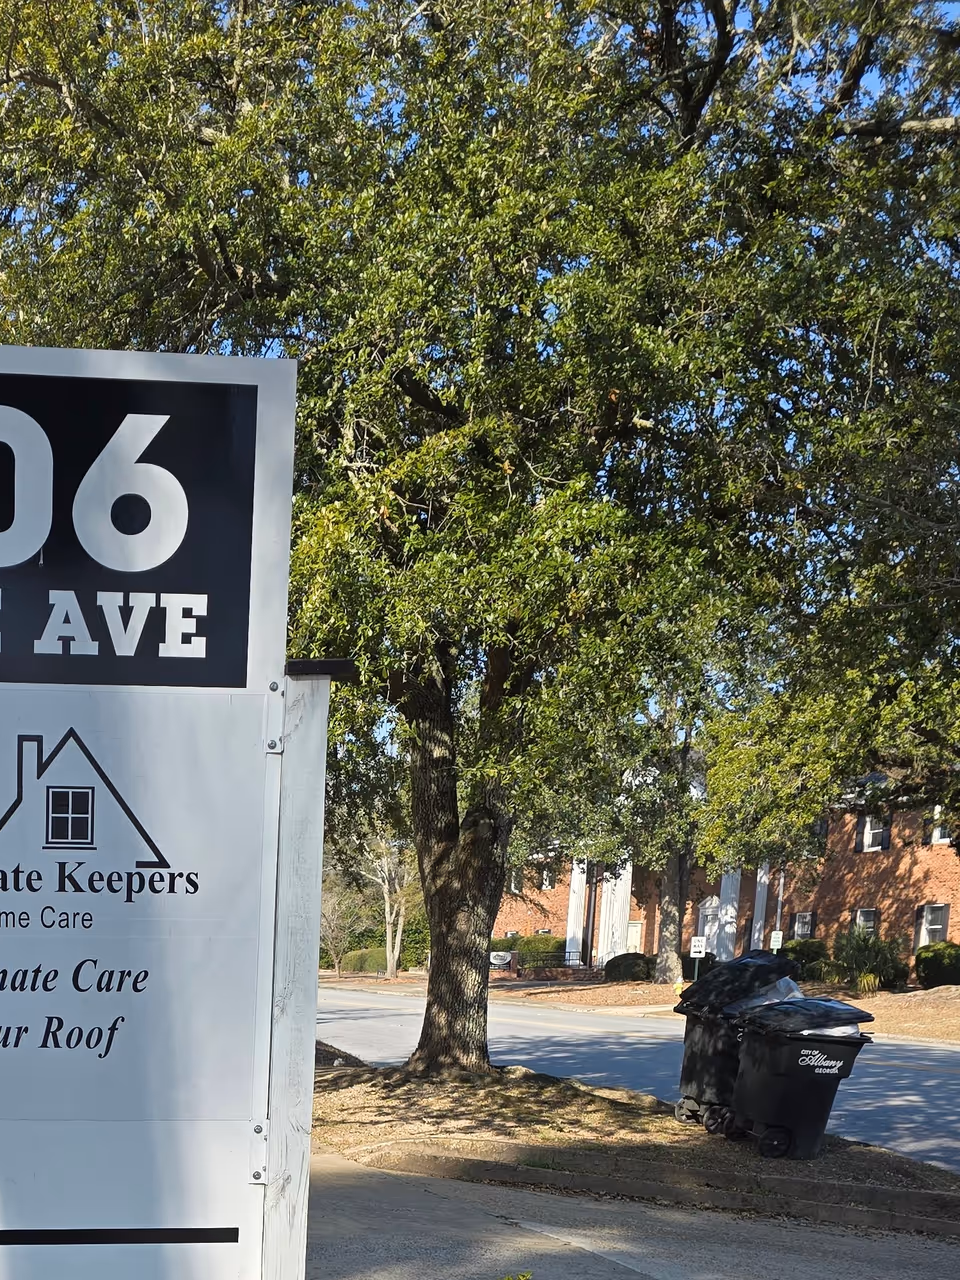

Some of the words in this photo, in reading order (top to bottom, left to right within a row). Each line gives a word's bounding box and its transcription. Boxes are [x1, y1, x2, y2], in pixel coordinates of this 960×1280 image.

[34, 590, 209, 659] AVE
[55, 861, 200, 903] Keepers
[40, 905, 93, 930] Care
[71, 958, 149, 993] Care
[37, 1015, 126, 1059] Roof
[798, 1053, 844, 1069] Albany
